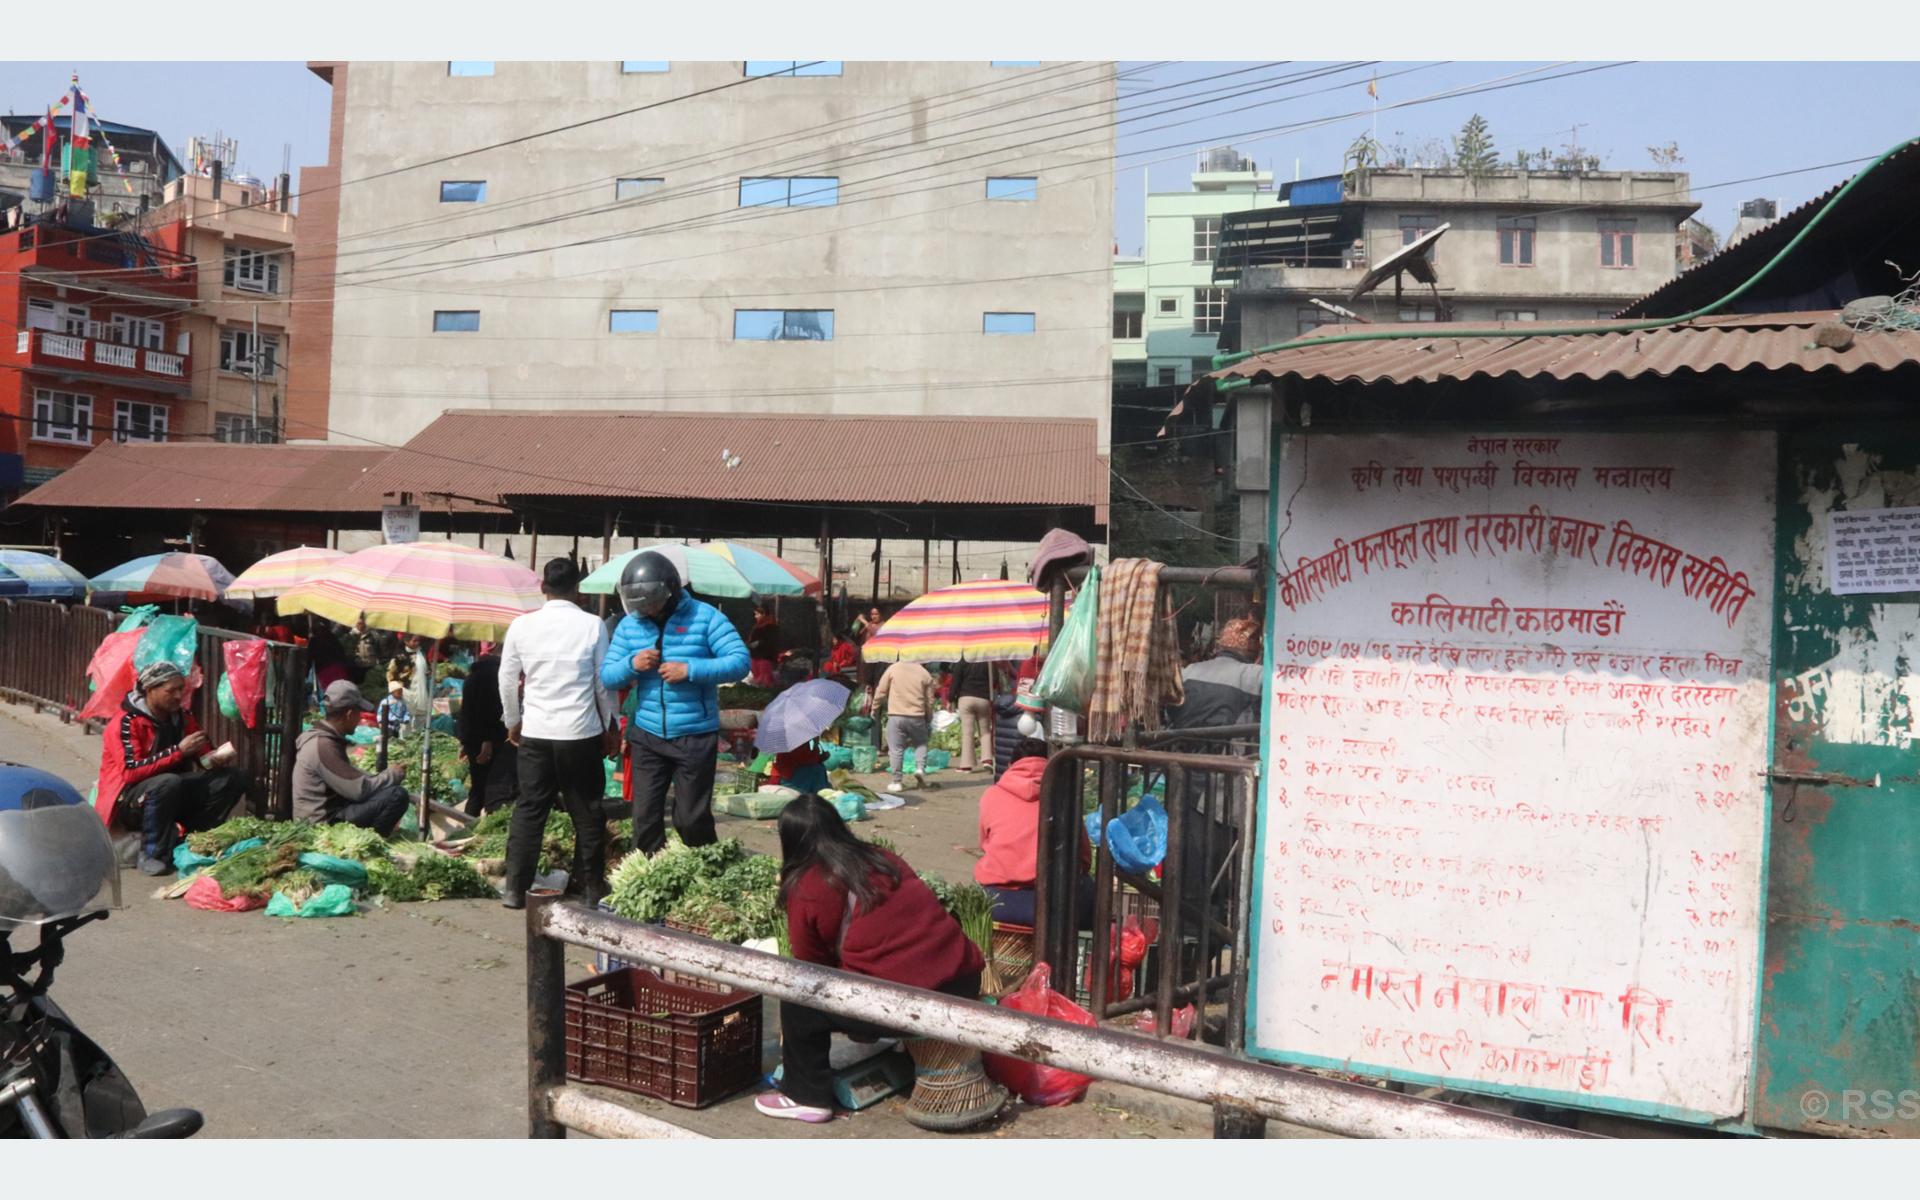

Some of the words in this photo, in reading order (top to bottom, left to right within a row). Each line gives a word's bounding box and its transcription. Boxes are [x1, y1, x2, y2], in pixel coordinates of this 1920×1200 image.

[1467, 437, 1508, 455] नेपाल
[1512, 438, 1561, 457] सरकार
[1351, 460, 1386, 491] कृषि
[1392, 466, 1424, 492] तथा
[1512, 459, 1581, 491] विकास
[1278, 538, 1352, 612] कालिमाटी
[1351, 522, 1418, 569] फलफूल
[1419, 516, 1460, 562] तथा
[1464, 504, 1547, 558] तरकारी
[1548, 515, 1606, 567] बजार
[1605, 519, 1684, 589] विकास
[1681, 553, 1756, 629] समिति
